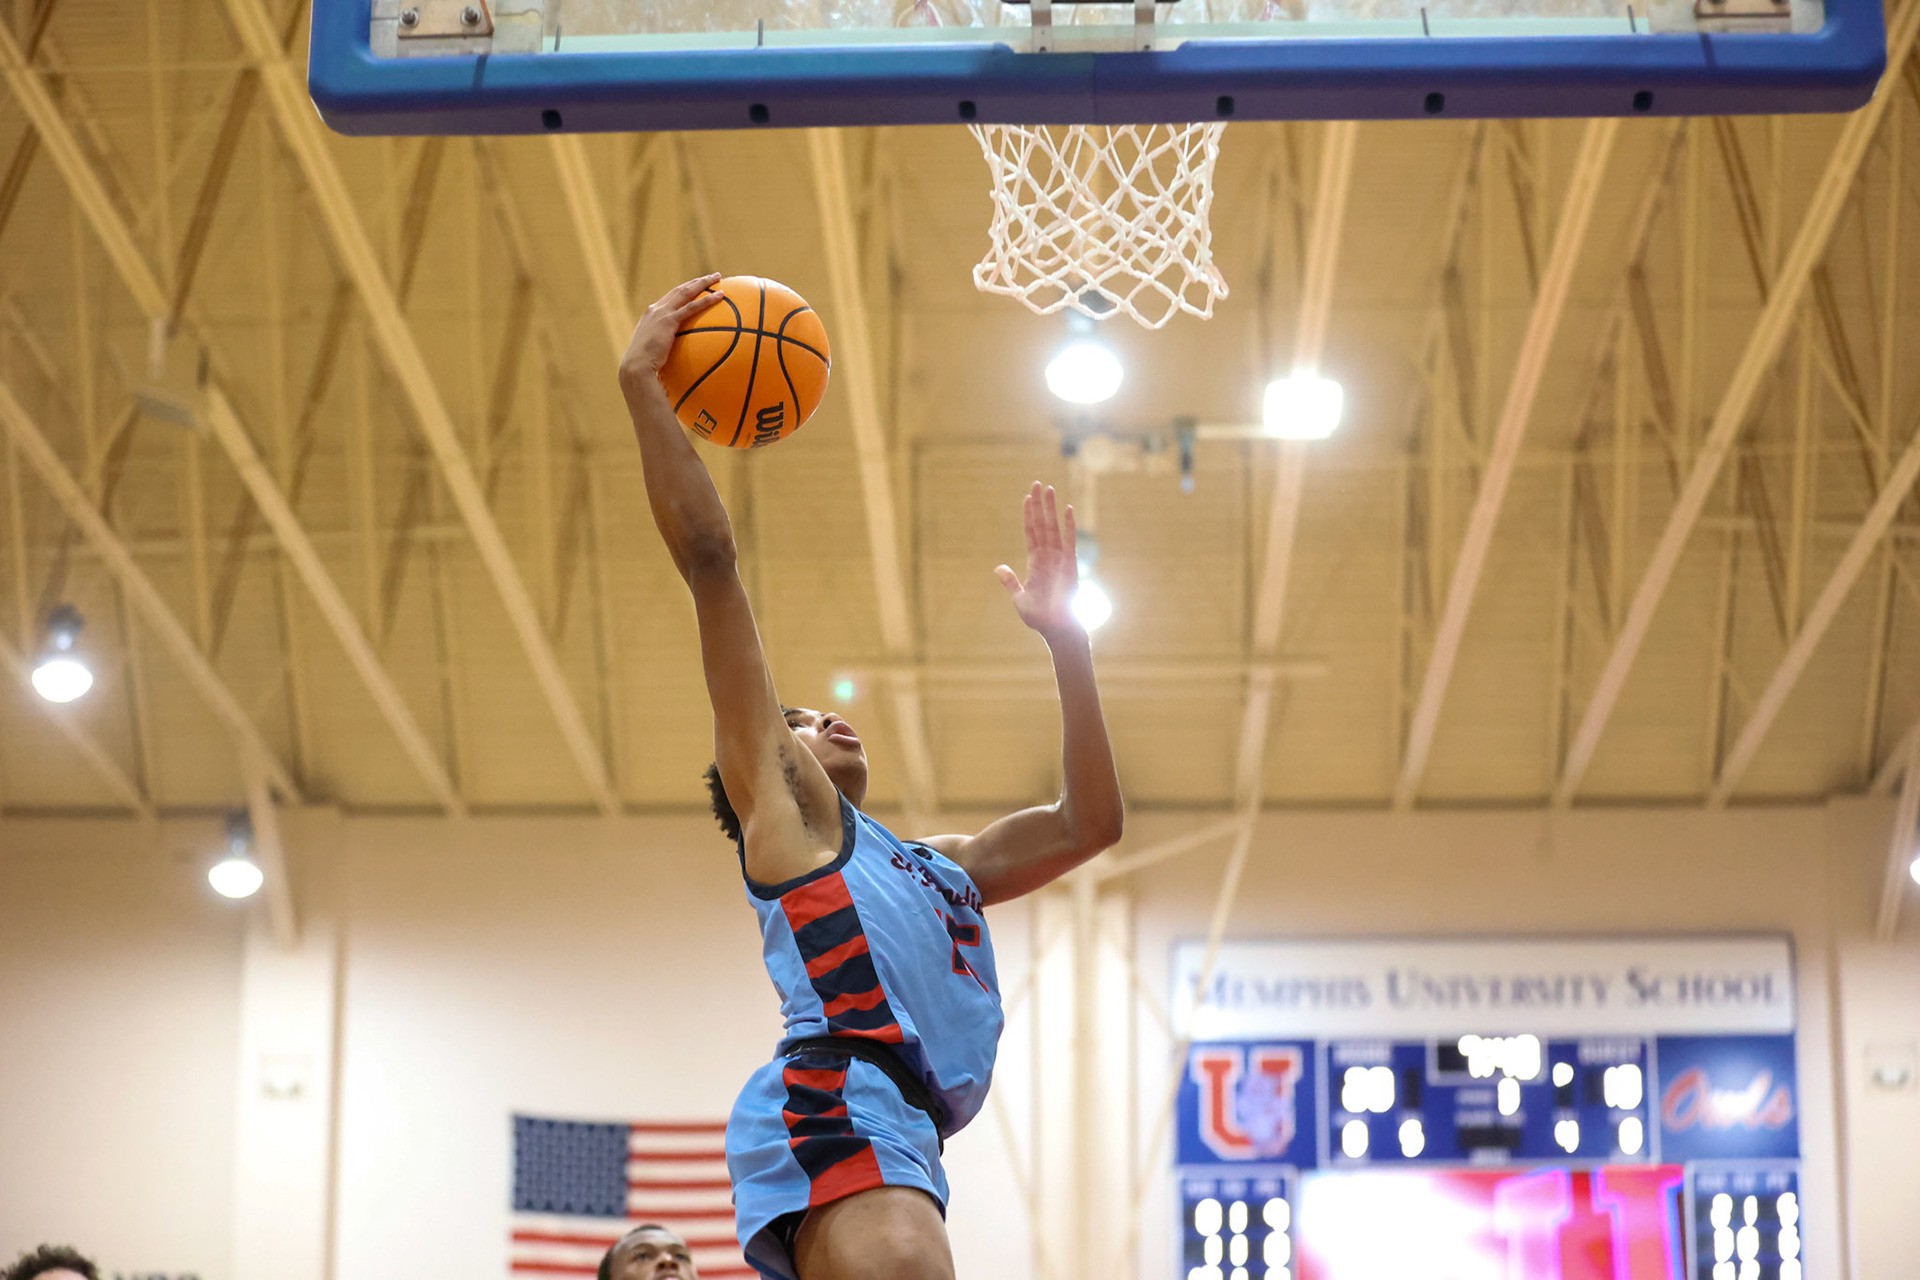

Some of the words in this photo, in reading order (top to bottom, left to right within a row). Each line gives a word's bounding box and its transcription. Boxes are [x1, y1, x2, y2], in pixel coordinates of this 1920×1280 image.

[1189, 969, 1373, 1009] MEMPHIS
[1385, 967, 1609, 1011] UNIVERSITY
[1626, 964, 1781, 1008] SCHOOL
[1661, 1063, 1794, 1134] Owls
